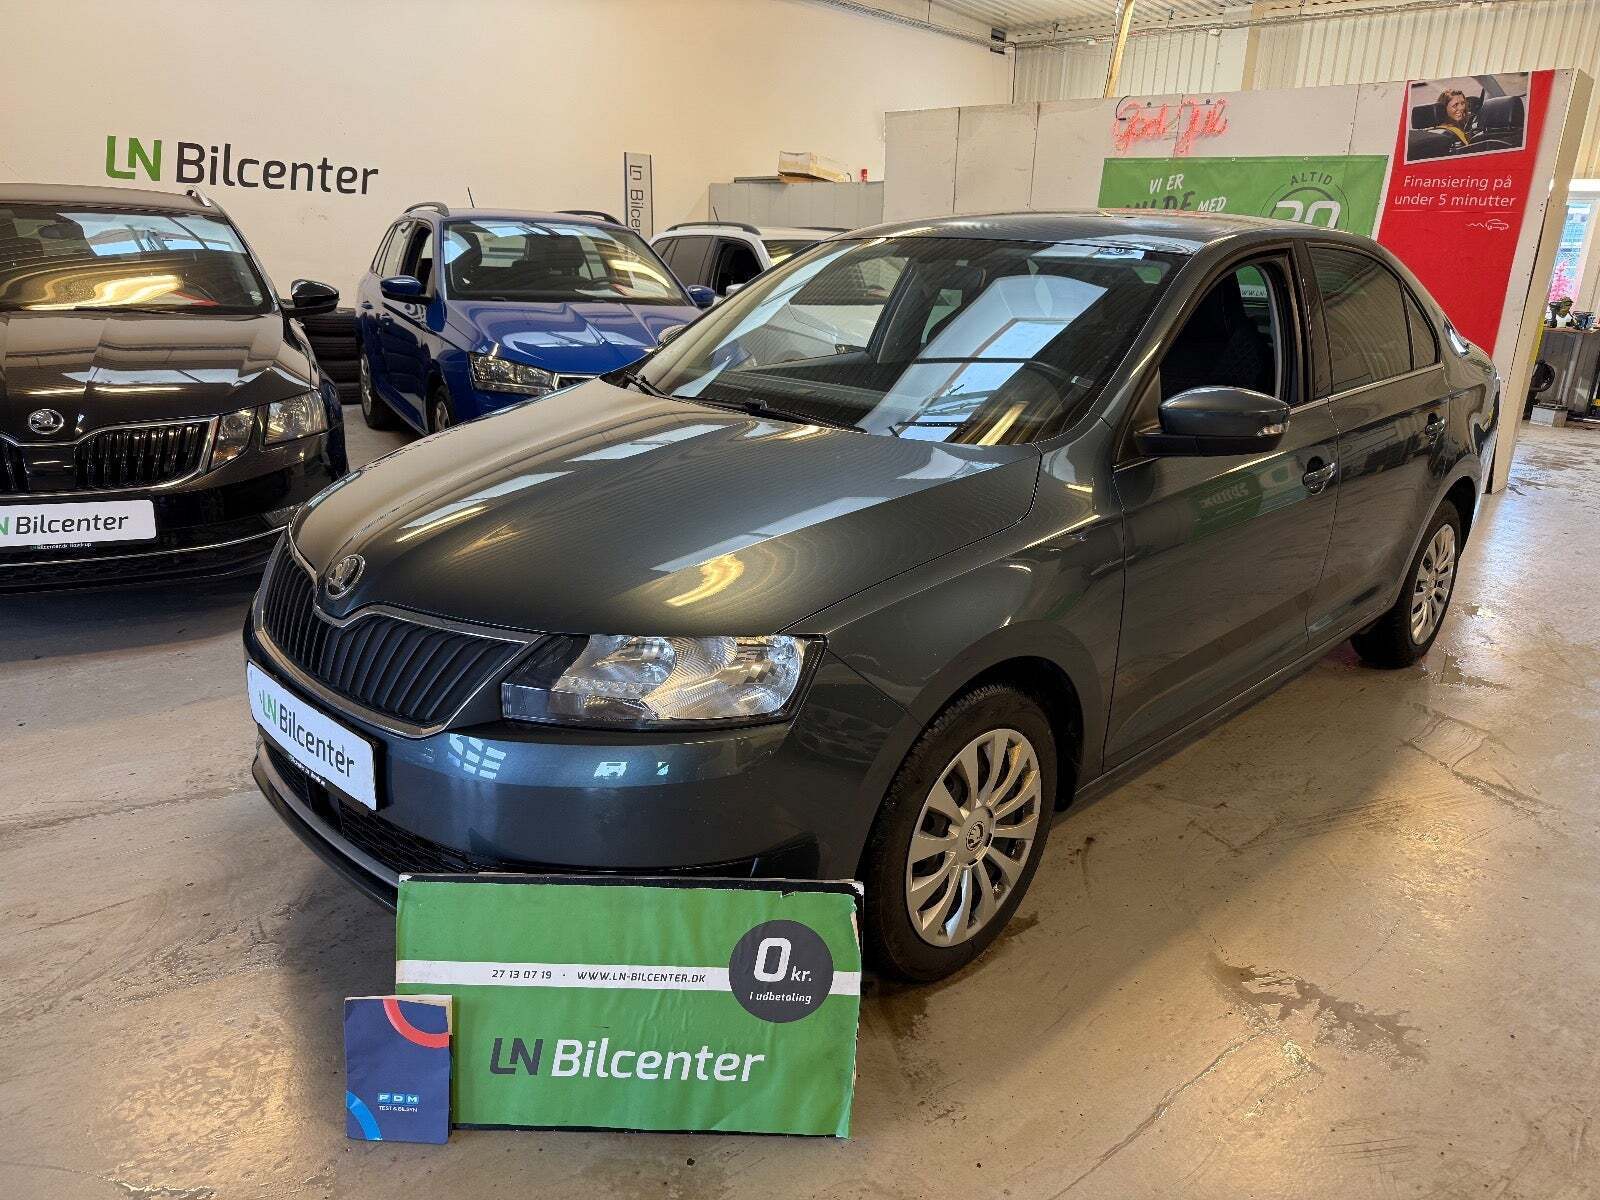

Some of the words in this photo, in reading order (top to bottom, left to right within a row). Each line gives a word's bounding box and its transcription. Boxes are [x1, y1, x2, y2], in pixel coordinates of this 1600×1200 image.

[105, 135, 162, 181] LN
[176, 141, 379, 194] Bilcenter
[1149, 178, 1162, 194] VI
[1166, 173, 1184, 191] ER
[1290, 172, 1333, 185] ALTID
[1403, 175, 1489, 190] Finansiering
[1492, 174, 1512, 191] på
[1197, 196, 1227, 212] MED
[1394, 193, 1435, 206] under
[1438, 193, 1448, 206] 5
[1450, 193, 1517, 207] minutter
[15, 514, 129, 535] Bilcenter
[262, 689, 277, 725] LN
[279, 703, 355, 778] Bilcenter
[753, 937, 792, 983] 0
[790, 965, 812, 982] kr.
[492, 969, 505, 978] 27
[509, 970, 520, 979] 13
[523, 970, 537, 979] 07
[542, 970, 552, 979] 19
[577, 971, 706, 983] WWW.LN-BILCENTER.DK
[756, 991, 812, 1005] udbetaling
[489, 1037, 544, 1076] LN
[551, 1037, 765, 1082] Bilcenter
[379, 1094, 418, 1103] FDM
